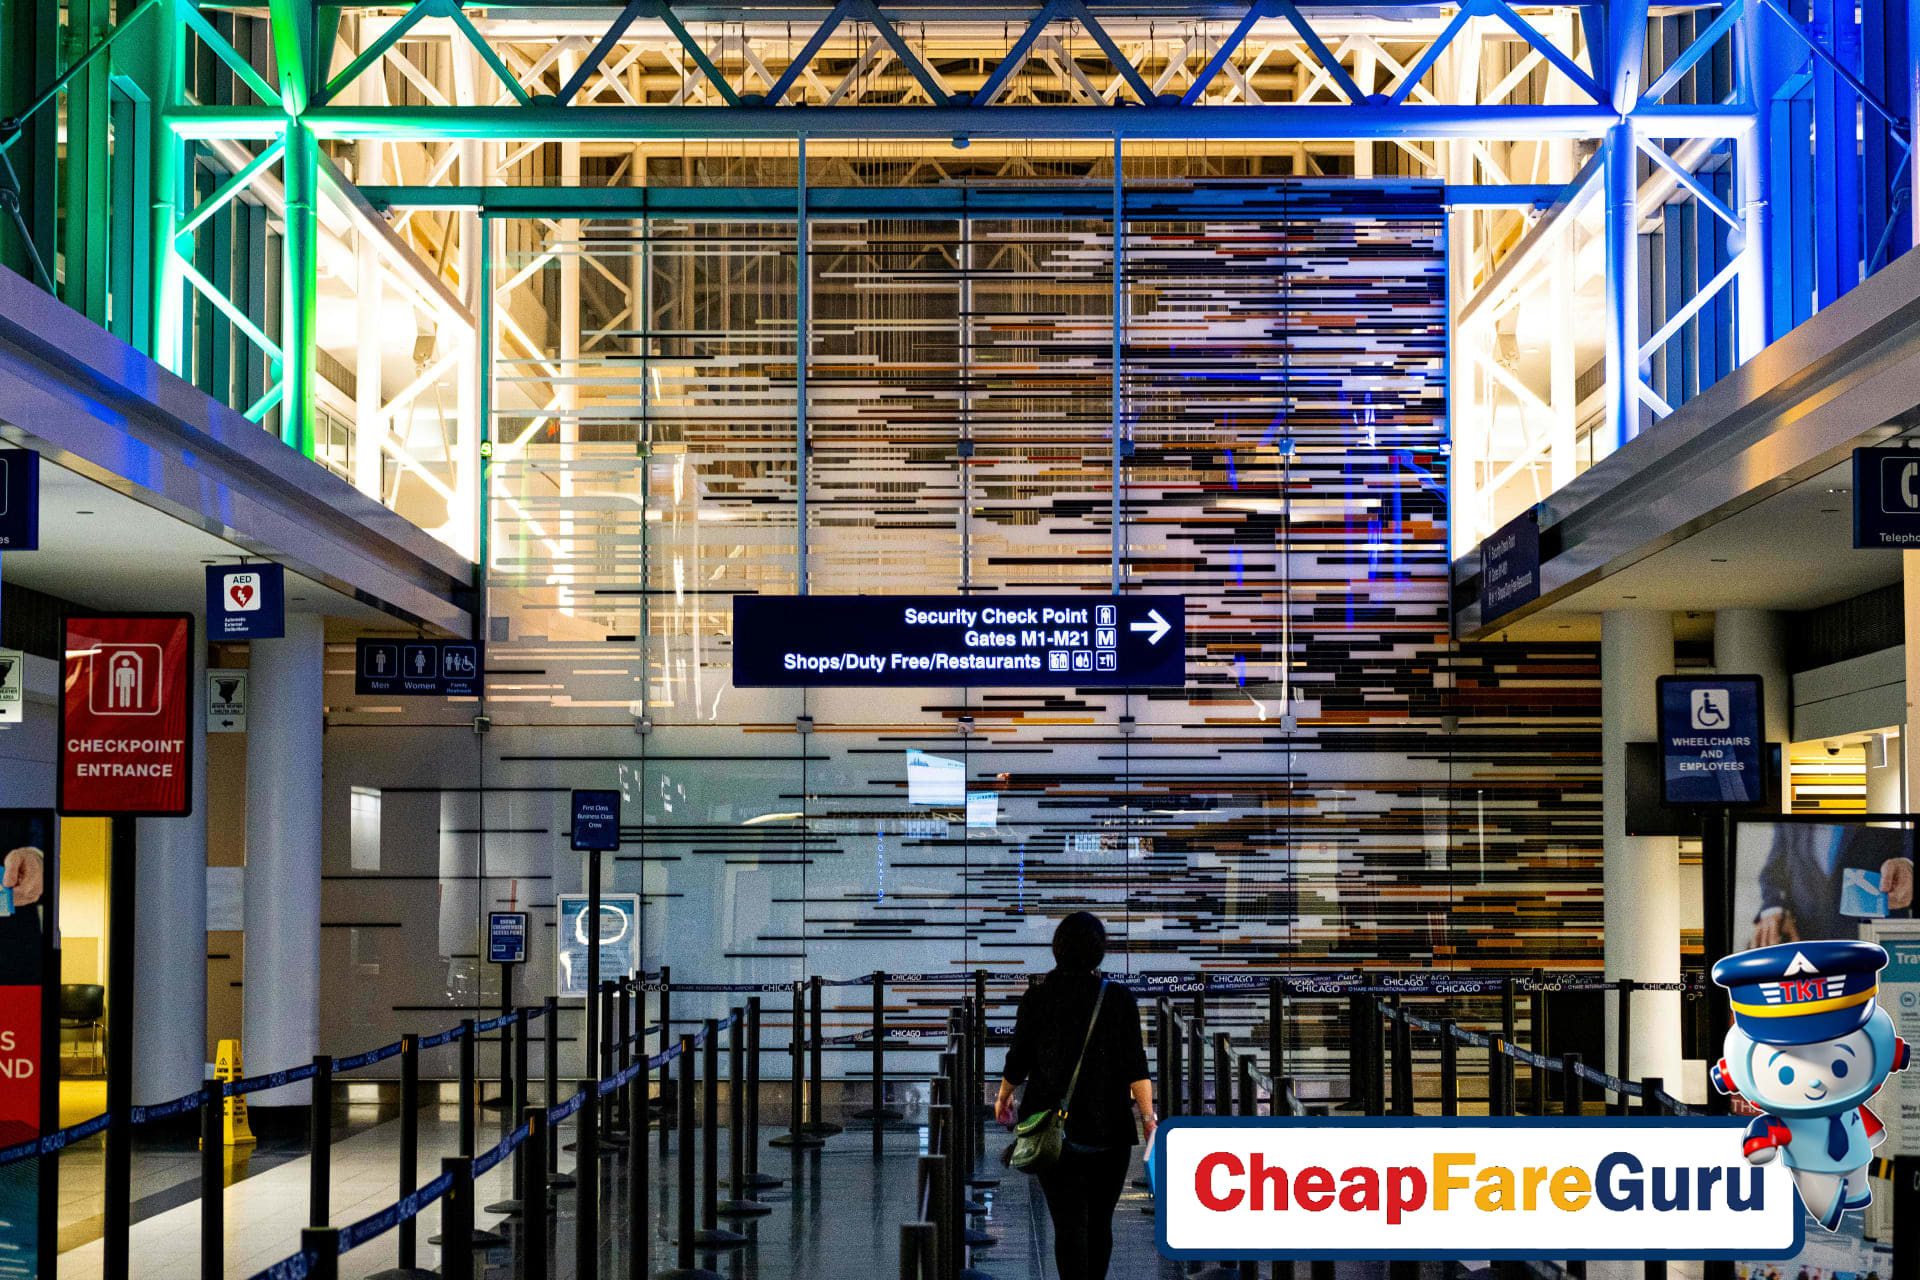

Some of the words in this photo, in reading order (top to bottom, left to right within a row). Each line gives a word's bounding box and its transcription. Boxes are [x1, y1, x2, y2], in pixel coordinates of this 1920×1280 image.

[233, 575, 252, 584] AED
[905, 607, 977, 627] Security
[982, 607, 1038, 624] Check
[1042, 607, 1088, 624] Point
[965, 630, 1016, 647] Gates
[1021, 630, 1088, 646] M1-M21
[1098, 631, 1114, 646] M
[784, 653, 886, 673] Shops/Duty
[891, 653, 1041, 671] Free/Restaurants
[371, 681, 390, 689] Men
[404, 681, 436, 690] Women
[67, 739, 184, 753] CHECKPOINT
[1672, 737, 1751, 746] WHEELCHAIRS
[1700, 750, 1724, 759] AND
[77, 763, 173, 777] ENTRANCE
[1679, 762, 1745, 771] EMPLOYEES
[891, 973, 922, 982] CHICAGO
[1147, 976, 1179, 985] CHICAGO
[1213, 975, 1253, 984] CHICAGO
[1382, 978, 1424, 987] CHICAGO
[624, 983, 669, 992] CHICAGO
[1168, 983, 1205, 992] CHICAGO
[1295, 984, 1341, 993] CHICAGO
[1435, 983, 1481, 993] CHICAGO
[1522, 983, 1562, 992] CHICAGO
[1642, 983, 1687, 992] CHICAGO
[890, 1029, 921, 1038] CHICAGO
